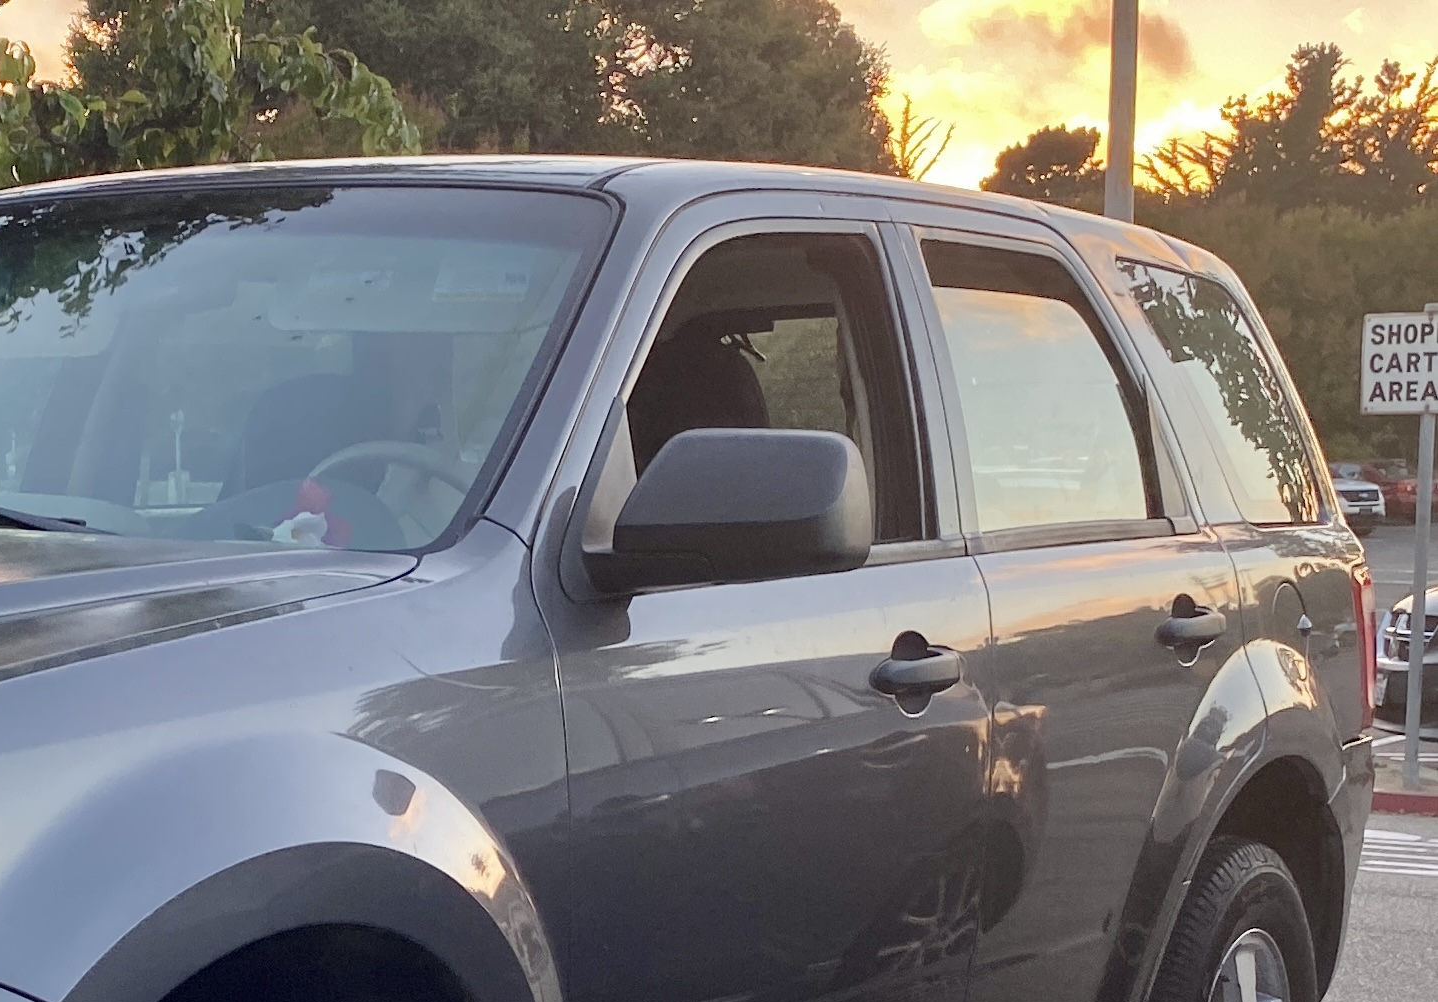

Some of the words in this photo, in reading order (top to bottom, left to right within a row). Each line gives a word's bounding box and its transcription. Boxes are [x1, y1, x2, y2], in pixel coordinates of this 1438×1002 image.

[1370, 323, 1438, 346] SHOP
[1369, 352, 1438, 374] CART
[1368, 381, 1438, 402] AREA
